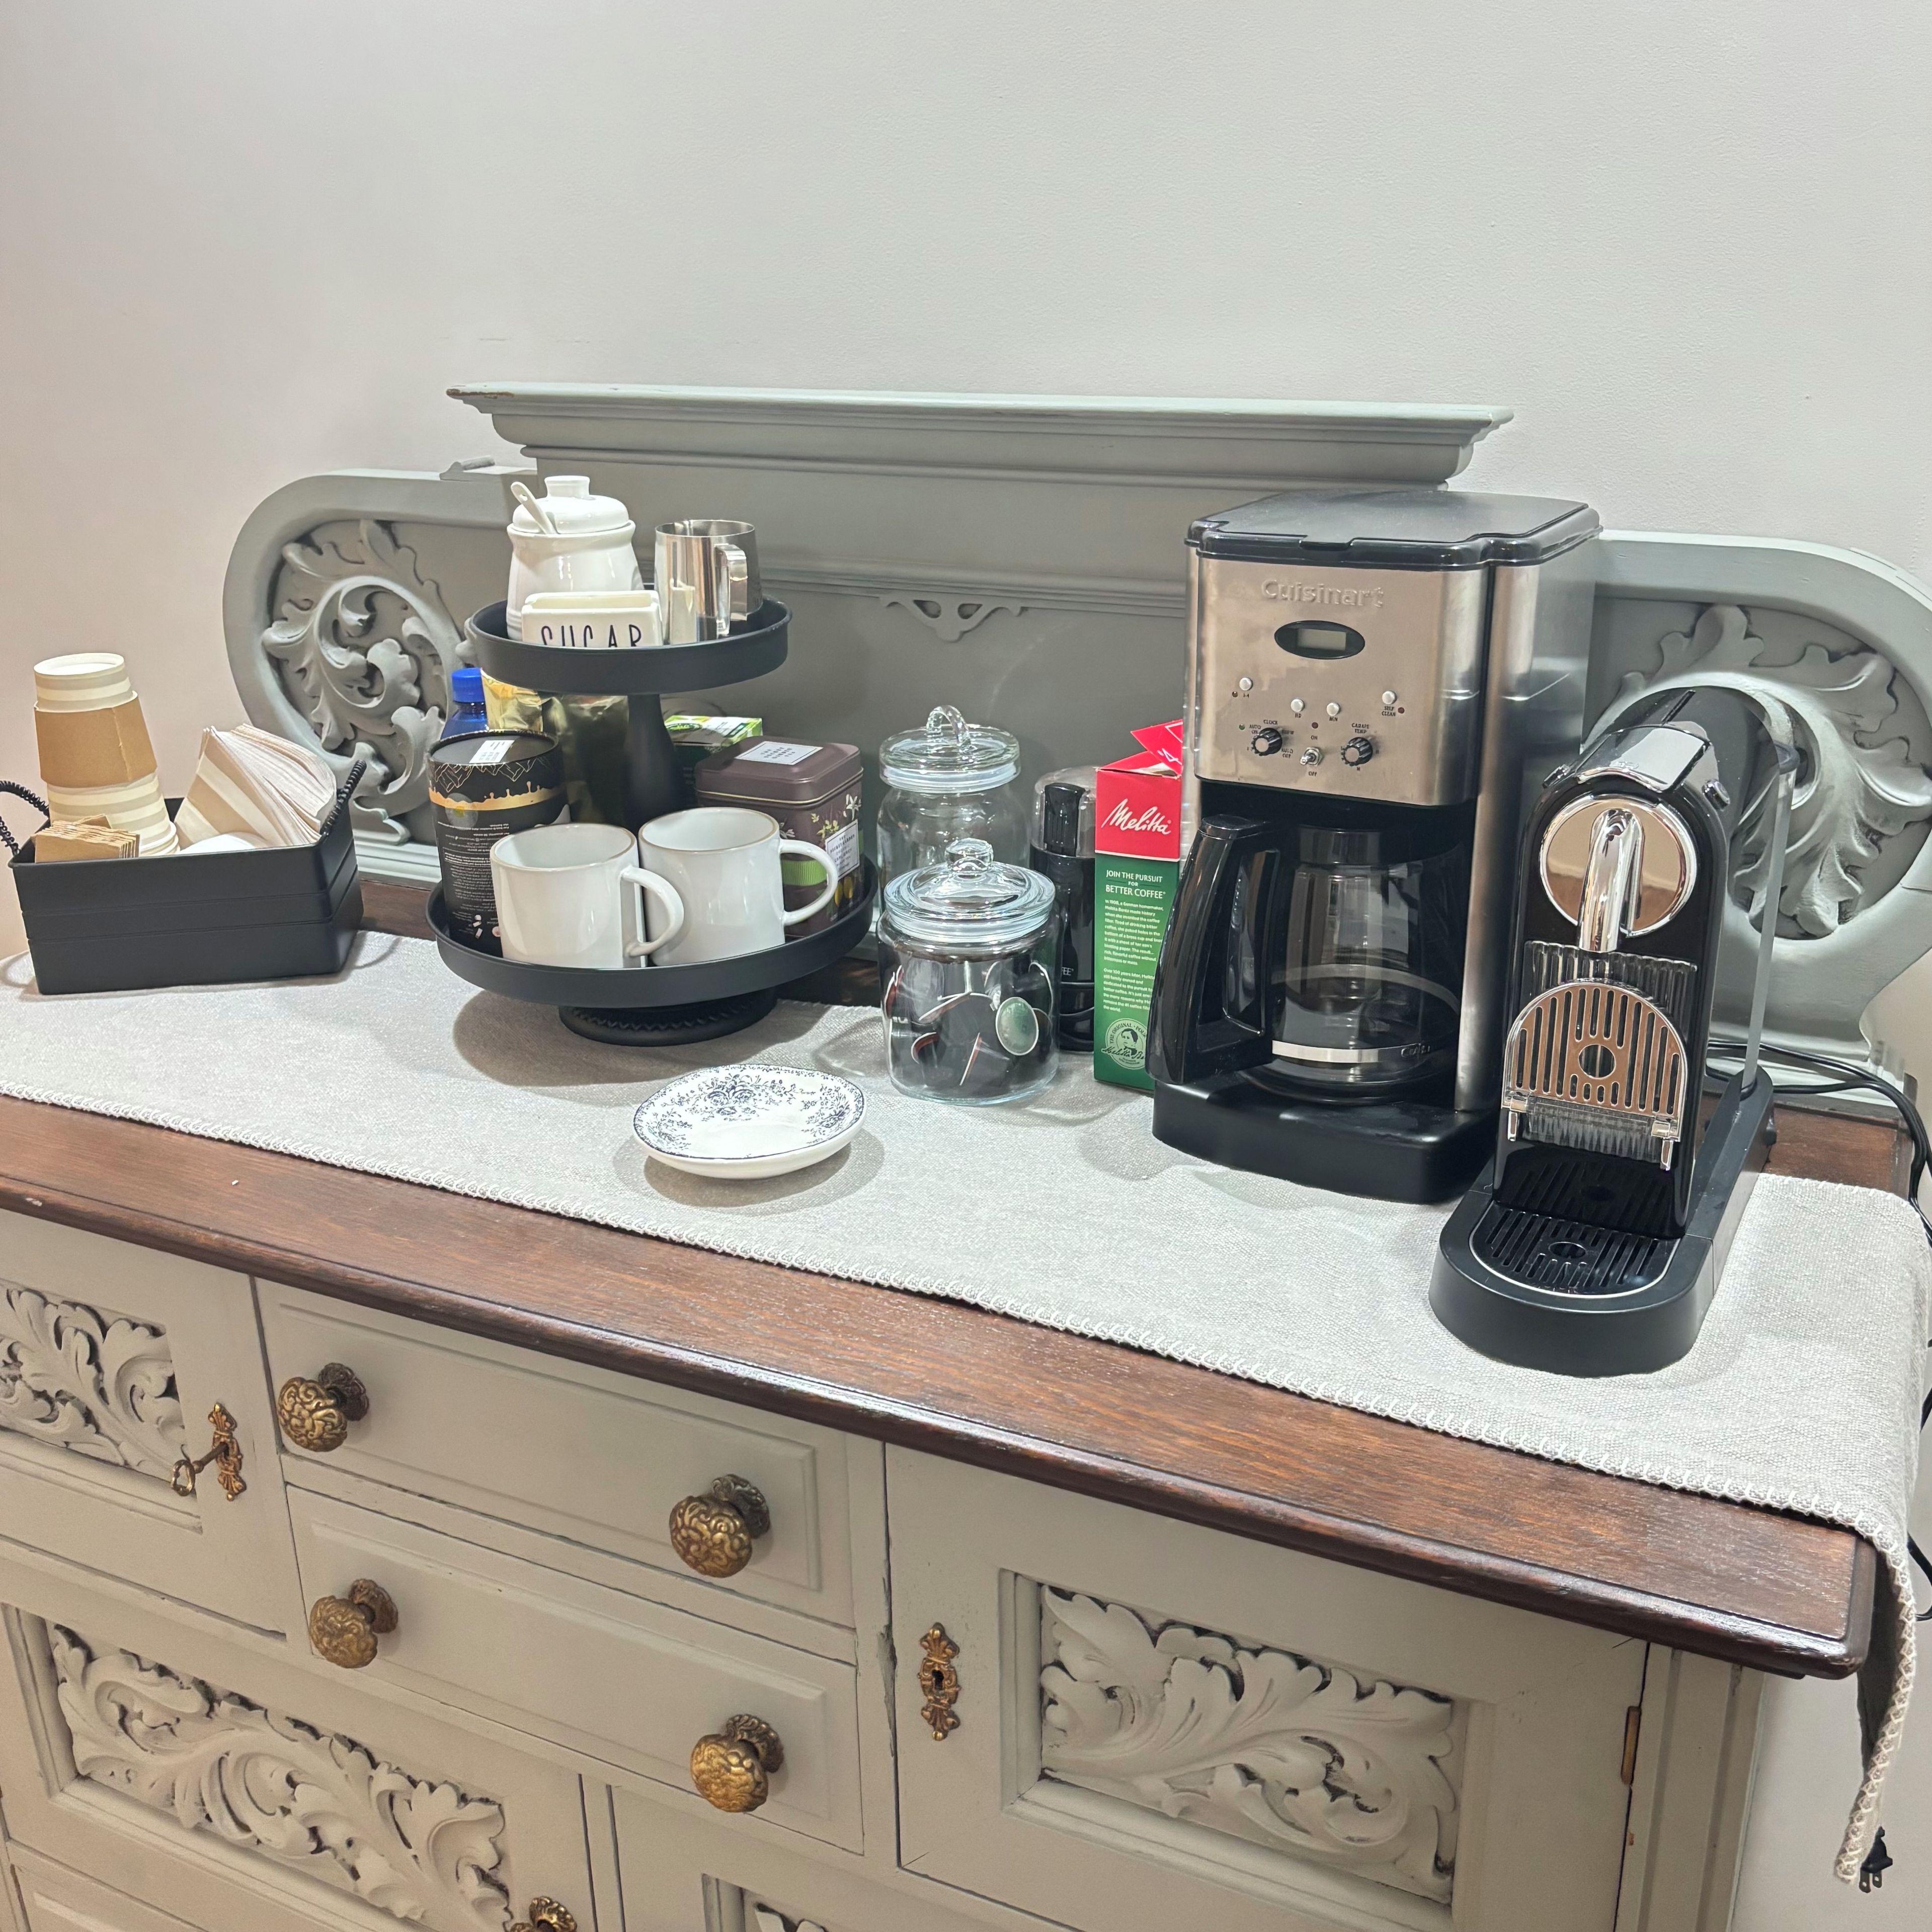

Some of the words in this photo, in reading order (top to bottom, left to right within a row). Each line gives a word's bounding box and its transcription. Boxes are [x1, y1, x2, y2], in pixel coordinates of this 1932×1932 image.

[1262, 579, 1384, 608] Cuisinart
[1101, 798, 1171, 835] Melitta
[1121, 871, 1134, 879] THE
[1135, 874, 1163, 882] PURSUIT
[1106, 884, 1133, 896] BETTER
